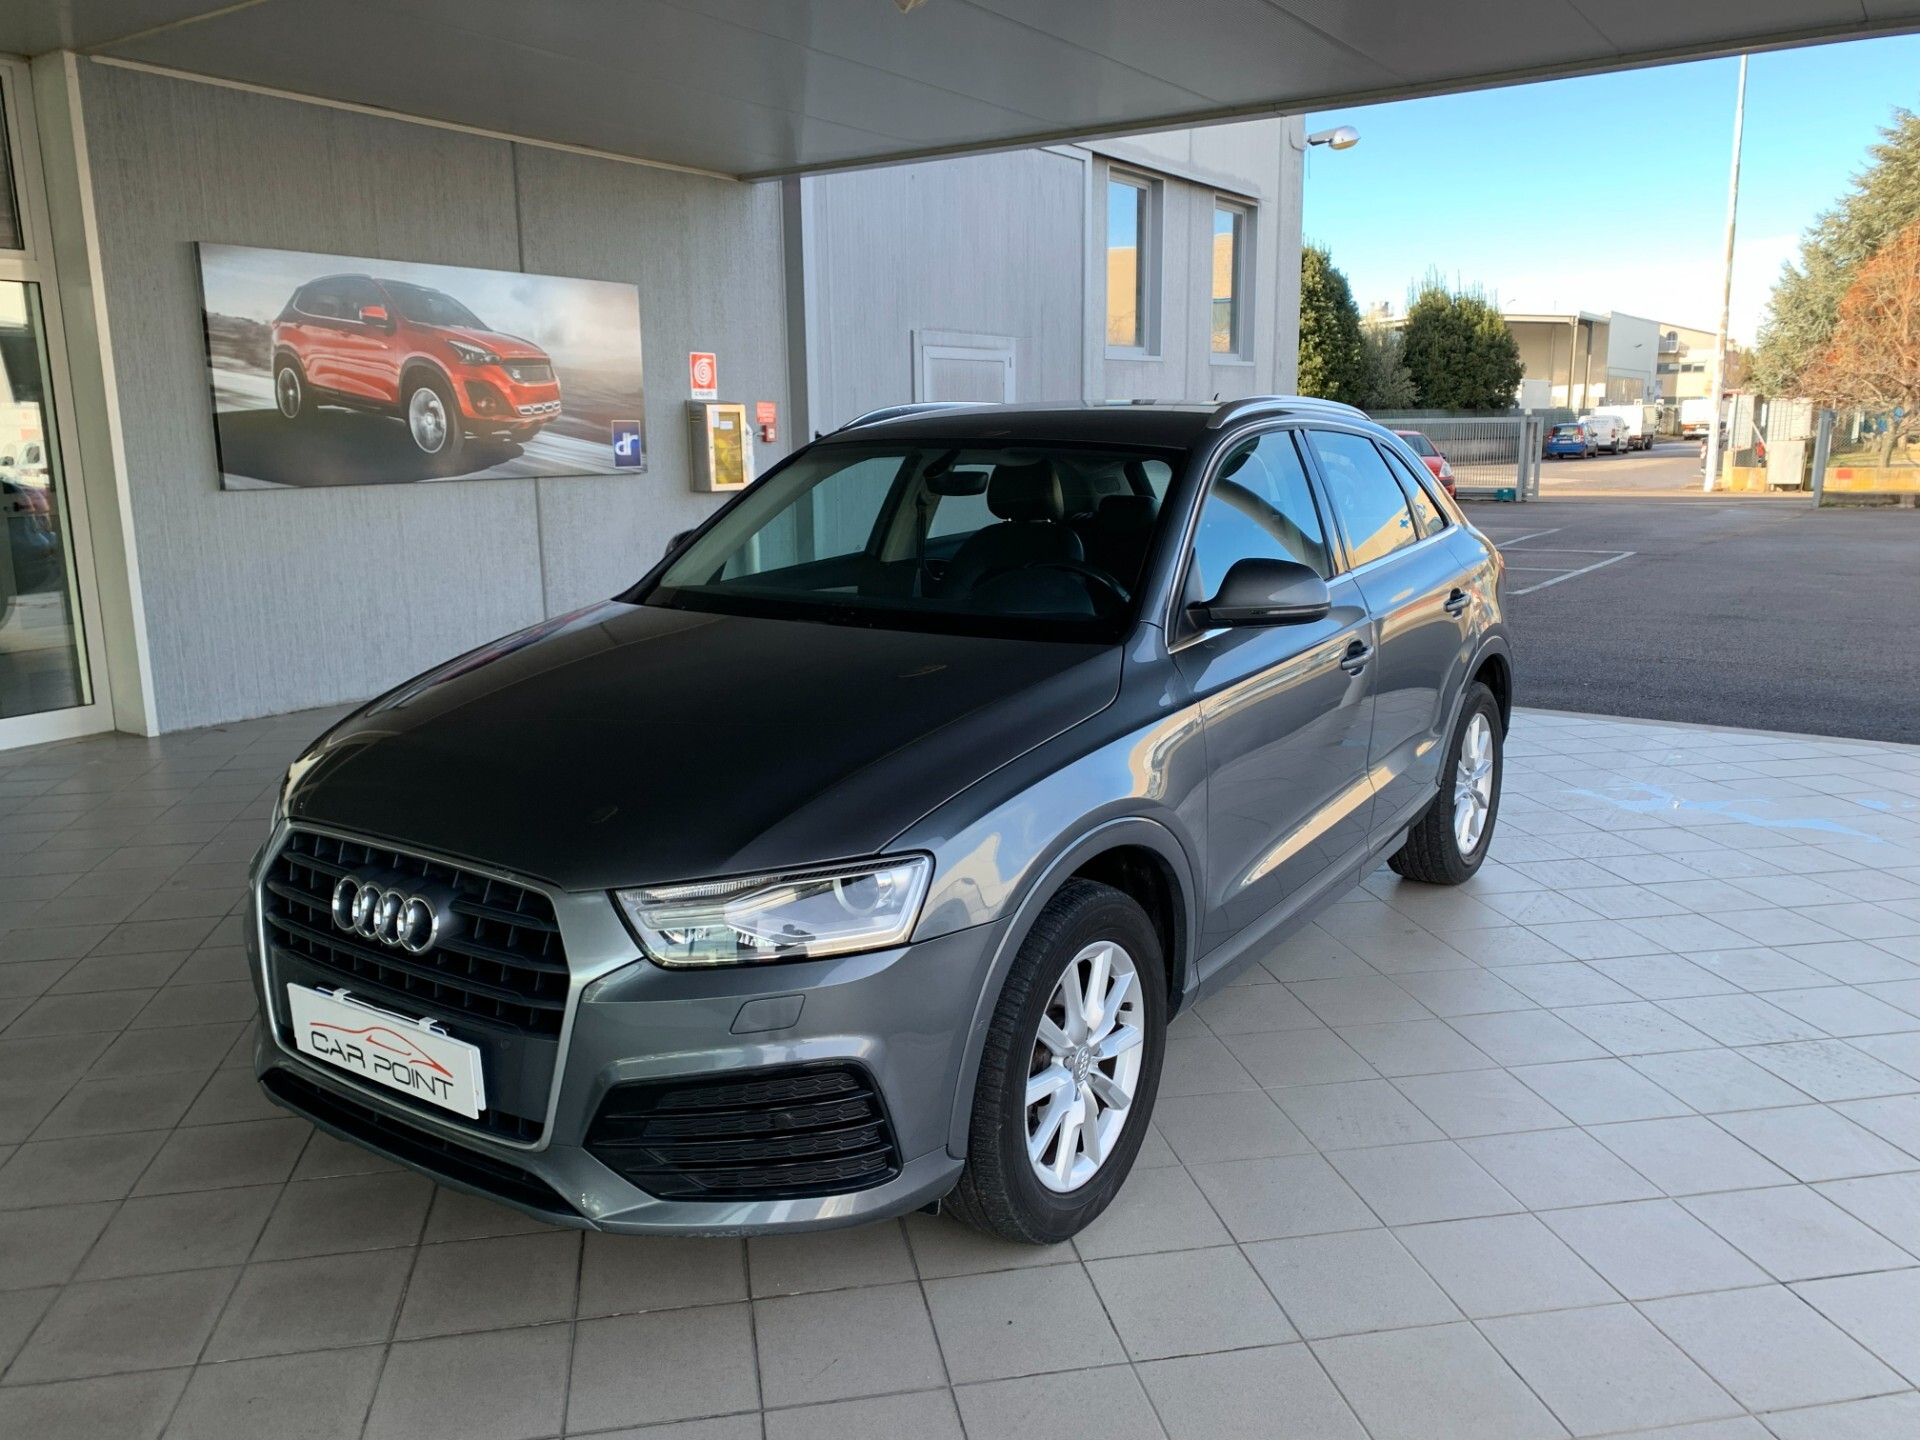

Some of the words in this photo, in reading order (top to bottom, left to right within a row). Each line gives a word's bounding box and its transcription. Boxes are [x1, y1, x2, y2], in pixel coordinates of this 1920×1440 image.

[615, 432, 638, 455] dr
[311, 1031, 366, 1069] CAR
[373, 1054, 454, 1100] POINT
